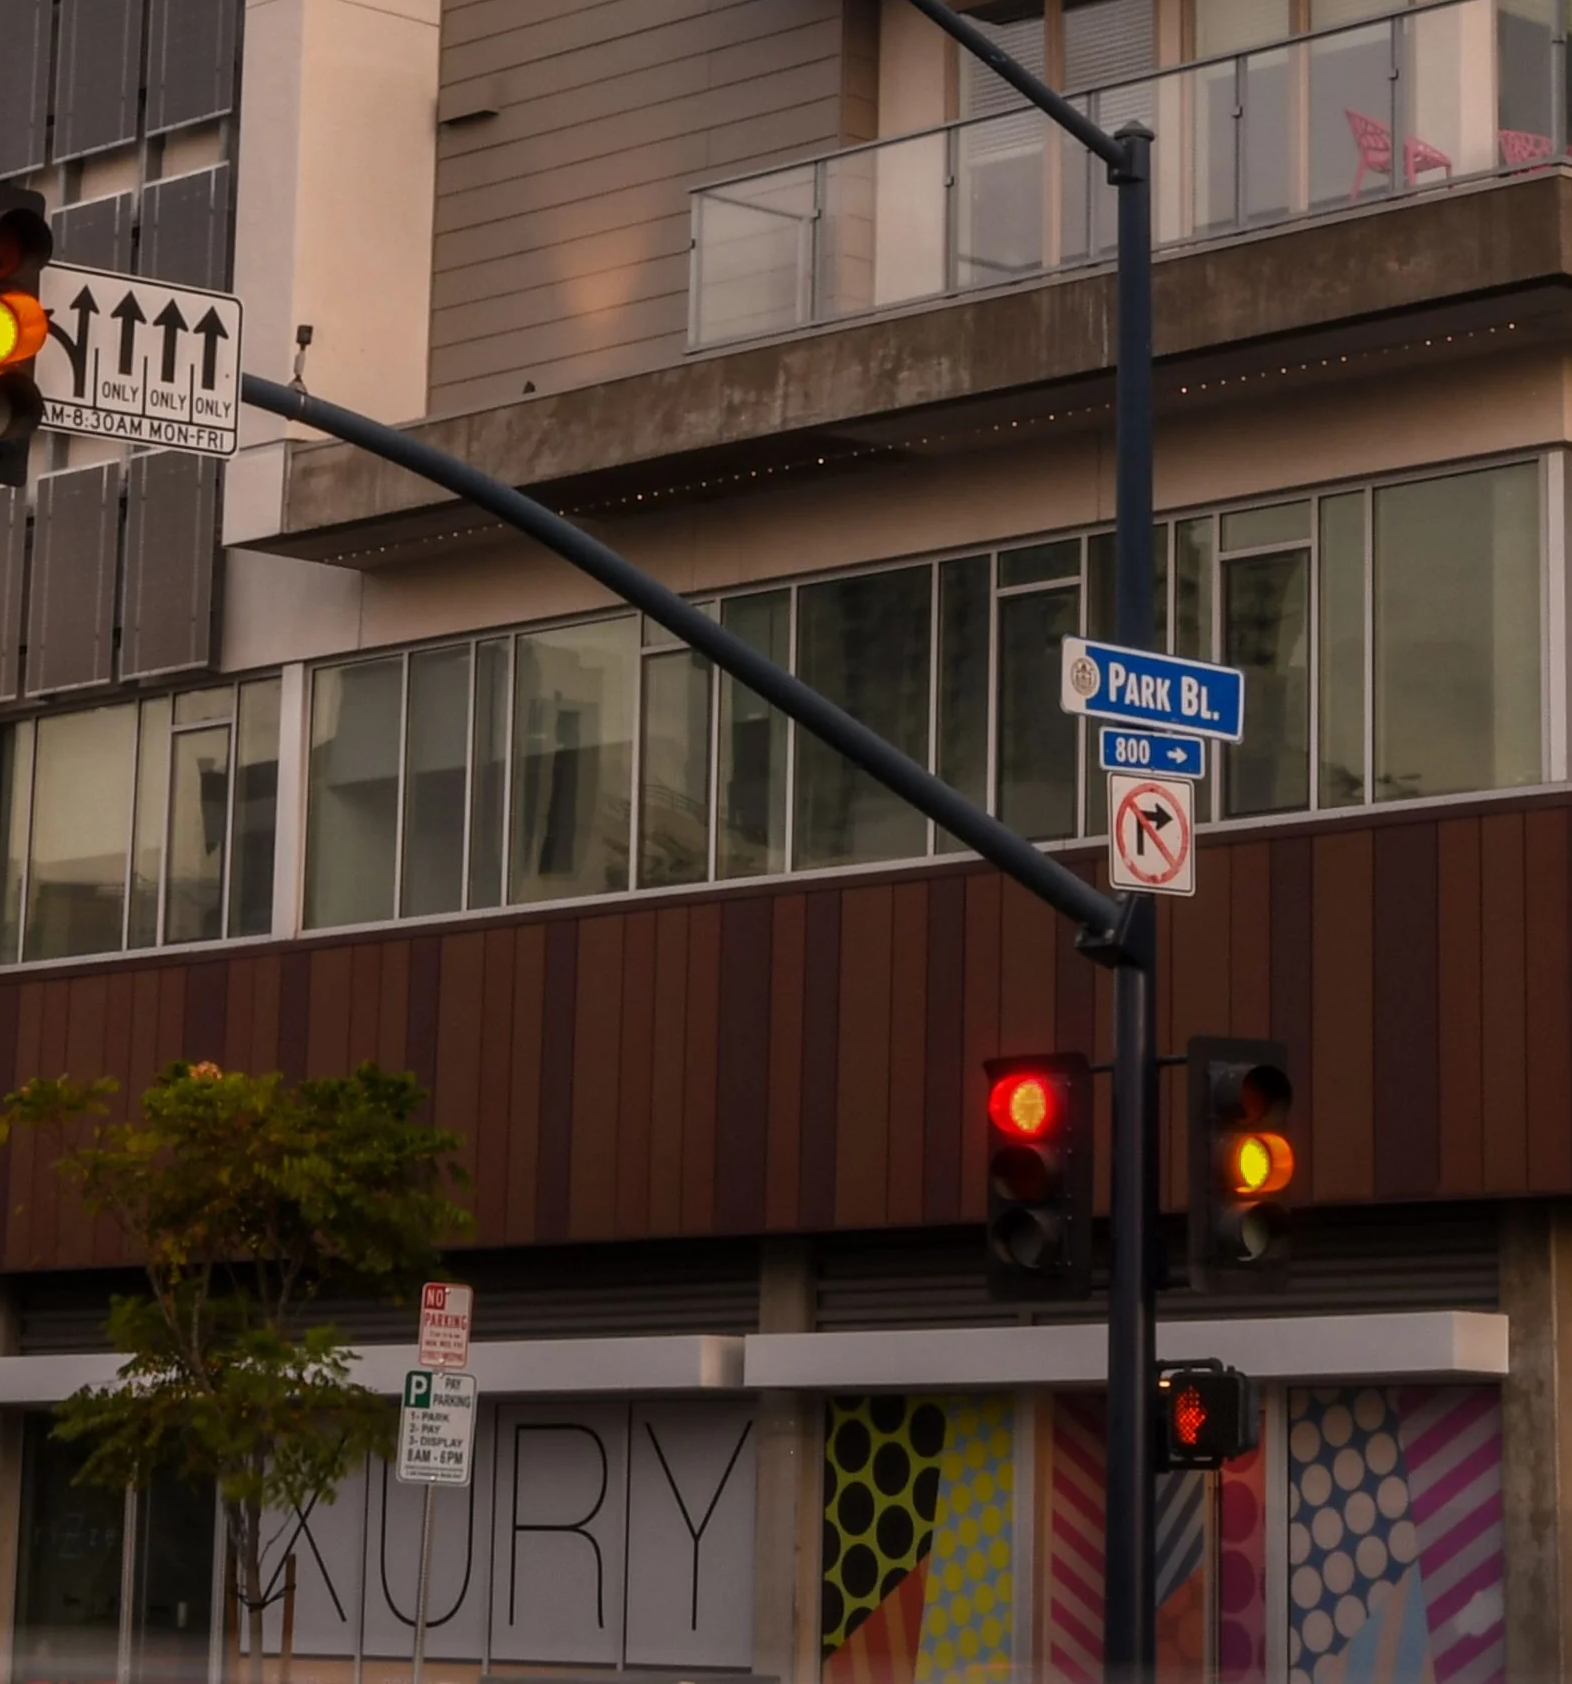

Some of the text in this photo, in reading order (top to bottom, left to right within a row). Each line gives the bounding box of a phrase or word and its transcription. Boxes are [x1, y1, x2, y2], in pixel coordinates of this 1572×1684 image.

[101, 380, 139, 404] ONLY
[149, 388, 187, 412] ONLY
[195, 396, 232, 419] ONLY
[41, 402, 225, 450] AM-8:30AM MON-FRI
[1108, 661, 1172, 713] PARK
[1115, 736, 1151, 765] 800
[426, 1289, 444, 1307] NO
[424, 1312, 468, 1330] PARKING
[409, 1375, 428, 1405] P
[445, 1378, 462, 1390] PAY
[433, 1394, 471, 1409] PARKING
[421, 1411, 449, 1423] PARK
[421, 1423, 441, 1433] PAY
[420, 1436, 464, 1448] DISPLAY
